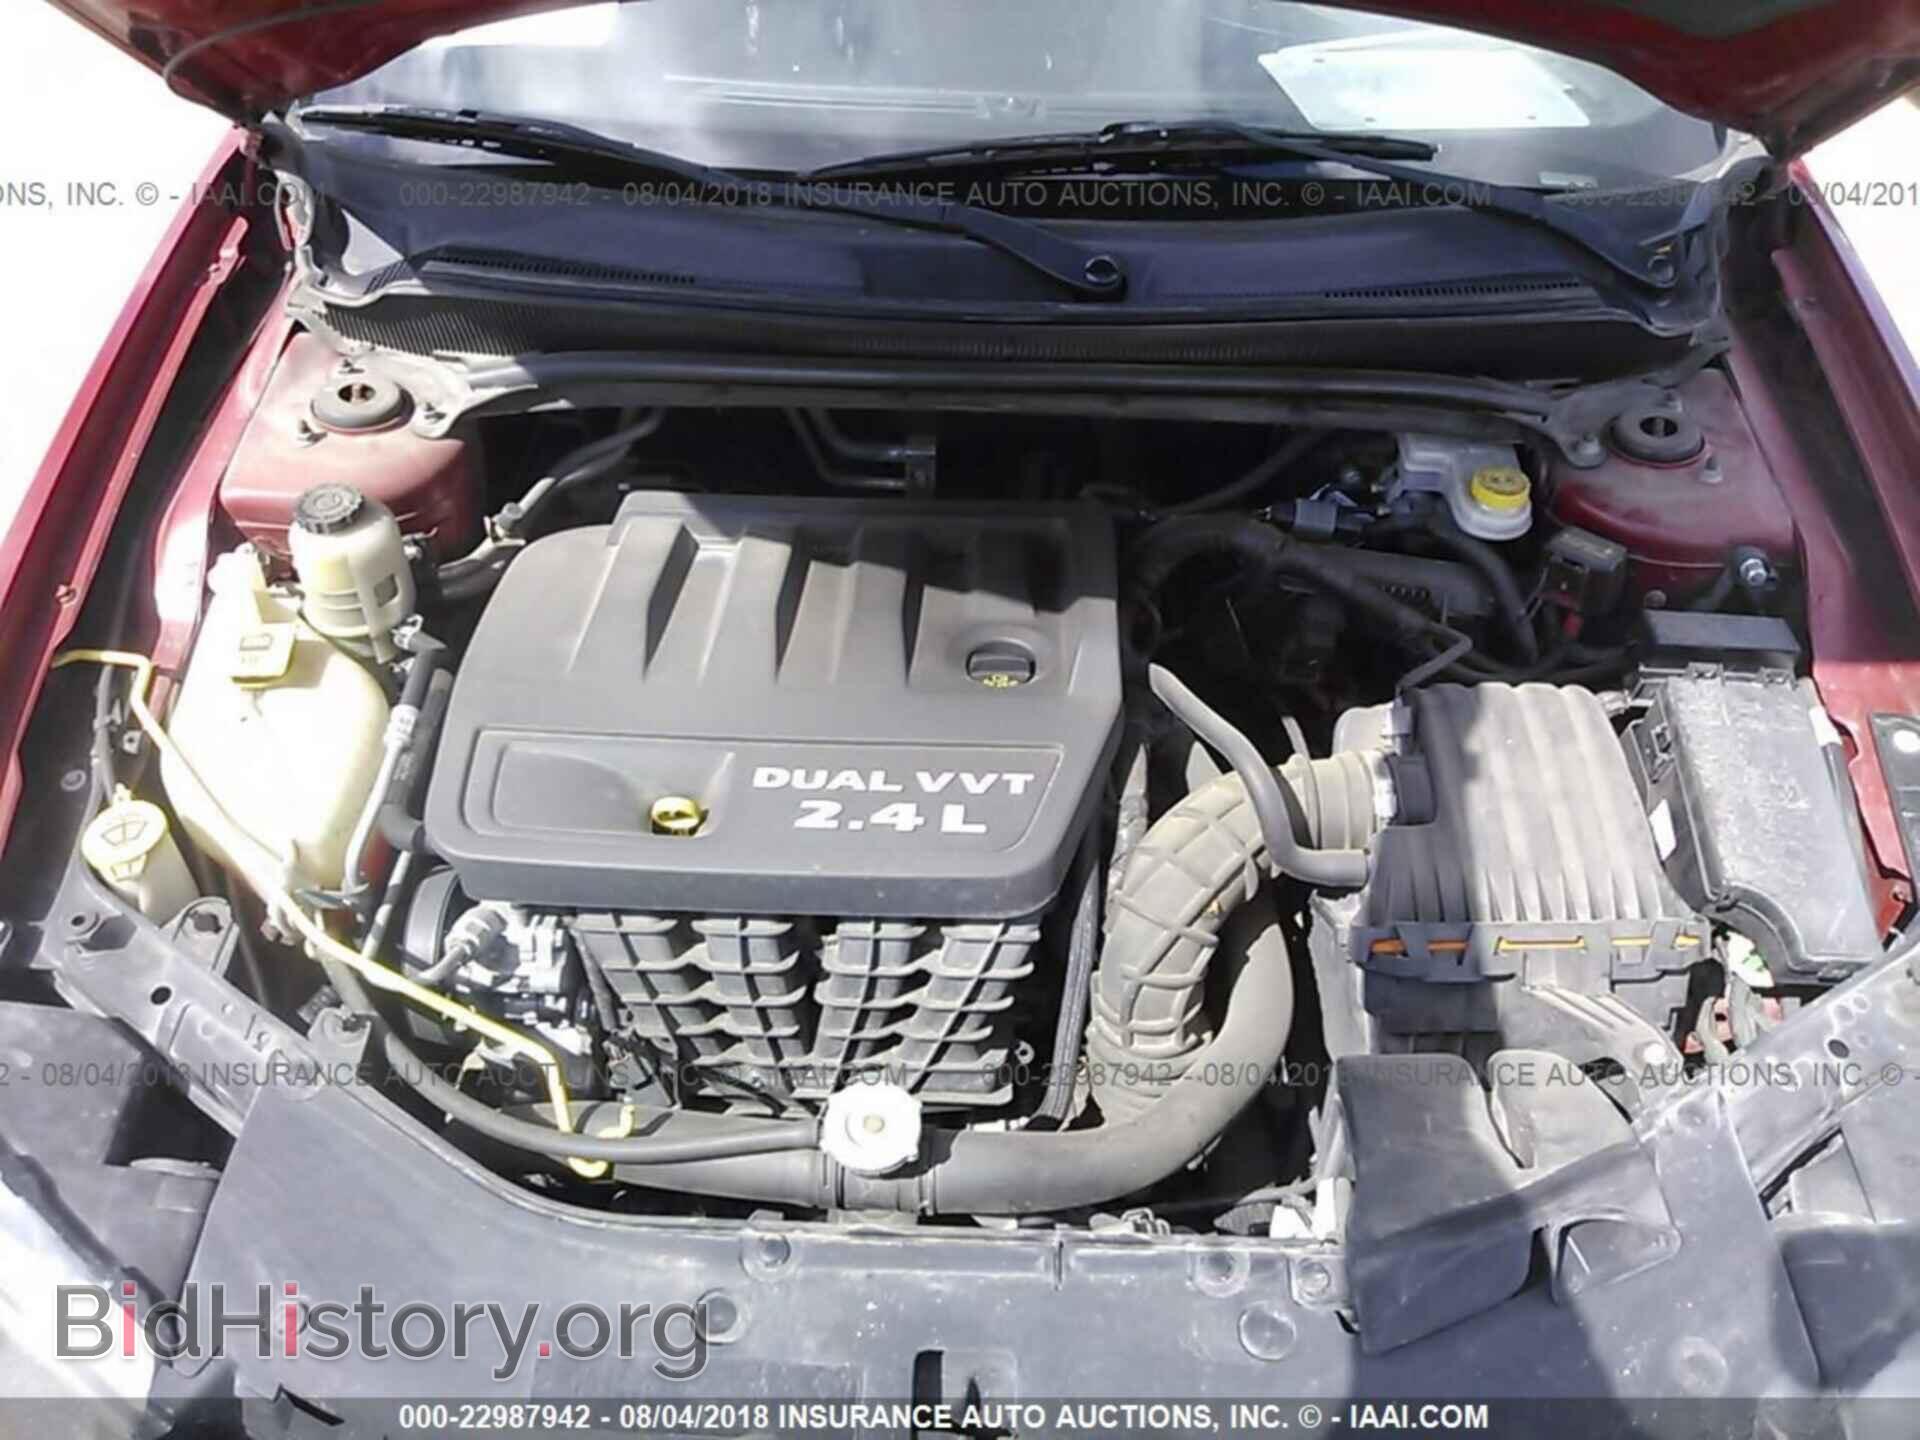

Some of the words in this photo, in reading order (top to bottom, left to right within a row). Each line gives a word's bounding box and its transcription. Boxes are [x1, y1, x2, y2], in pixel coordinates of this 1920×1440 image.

[752, 767, 903, 792] DUAL
[915, 771, 1036, 795] VVT
[794, 799, 926, 832] 2.4
[941, 803, 987, 833] L
